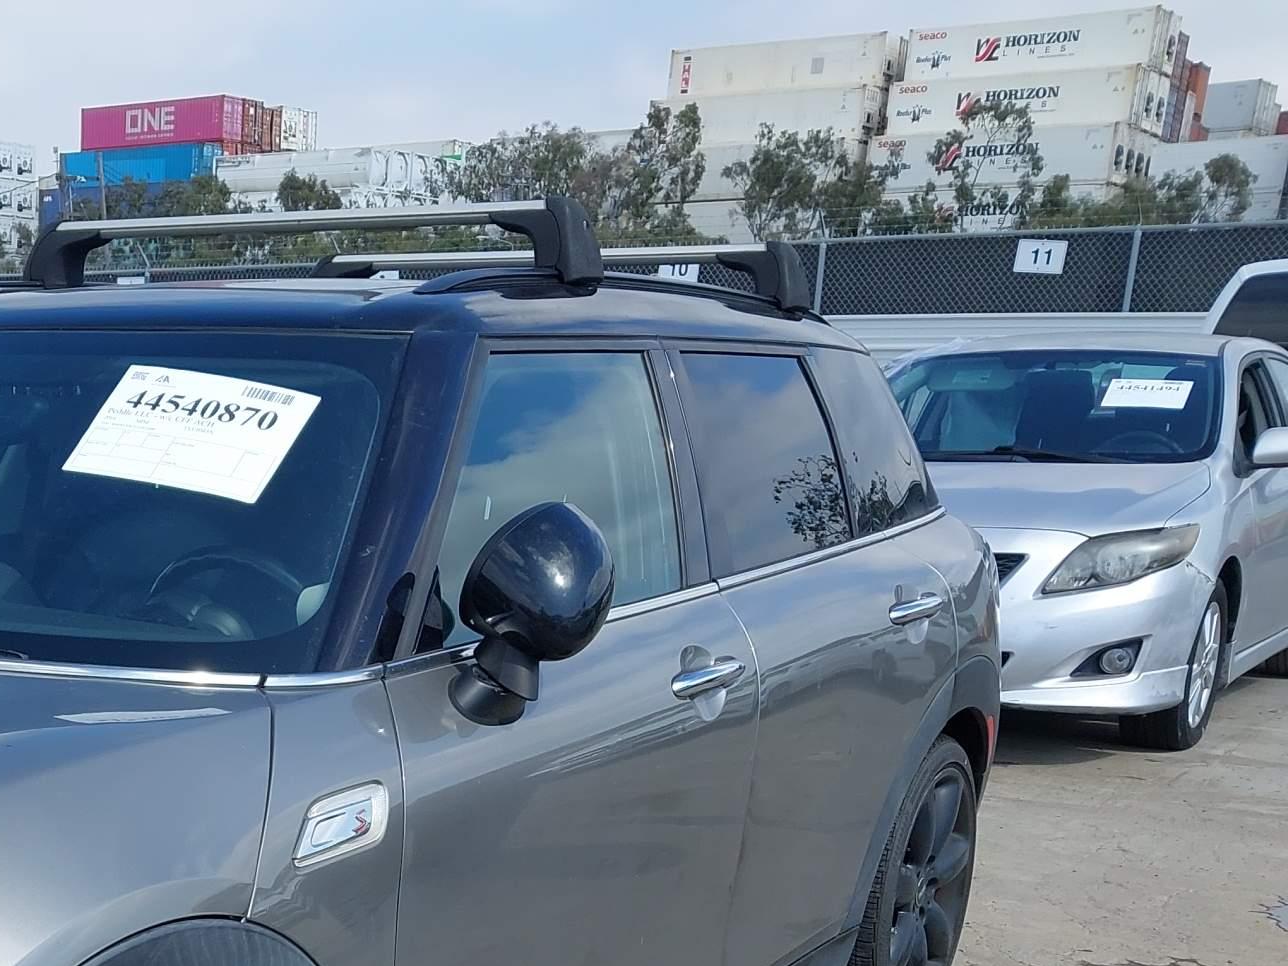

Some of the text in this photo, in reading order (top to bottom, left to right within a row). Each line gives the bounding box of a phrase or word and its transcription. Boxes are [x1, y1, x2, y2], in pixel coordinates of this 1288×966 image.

[918, 32, 948, 41] seaco
[1005, 29, 1081, 48] HORIZON
[1003, 44, 1066, 57] LINES
[899, 85, 928, 94] seaco
[985, 86, 1061, 102] HORIZON
[125, 106, 175, 134] ONE
[965, 142, 1040, 158] HORIZON
[1031, 247, 1053, 265] 11
[671, 264, 689, 277] 10
[126, 389, 279, 431] 44540870
